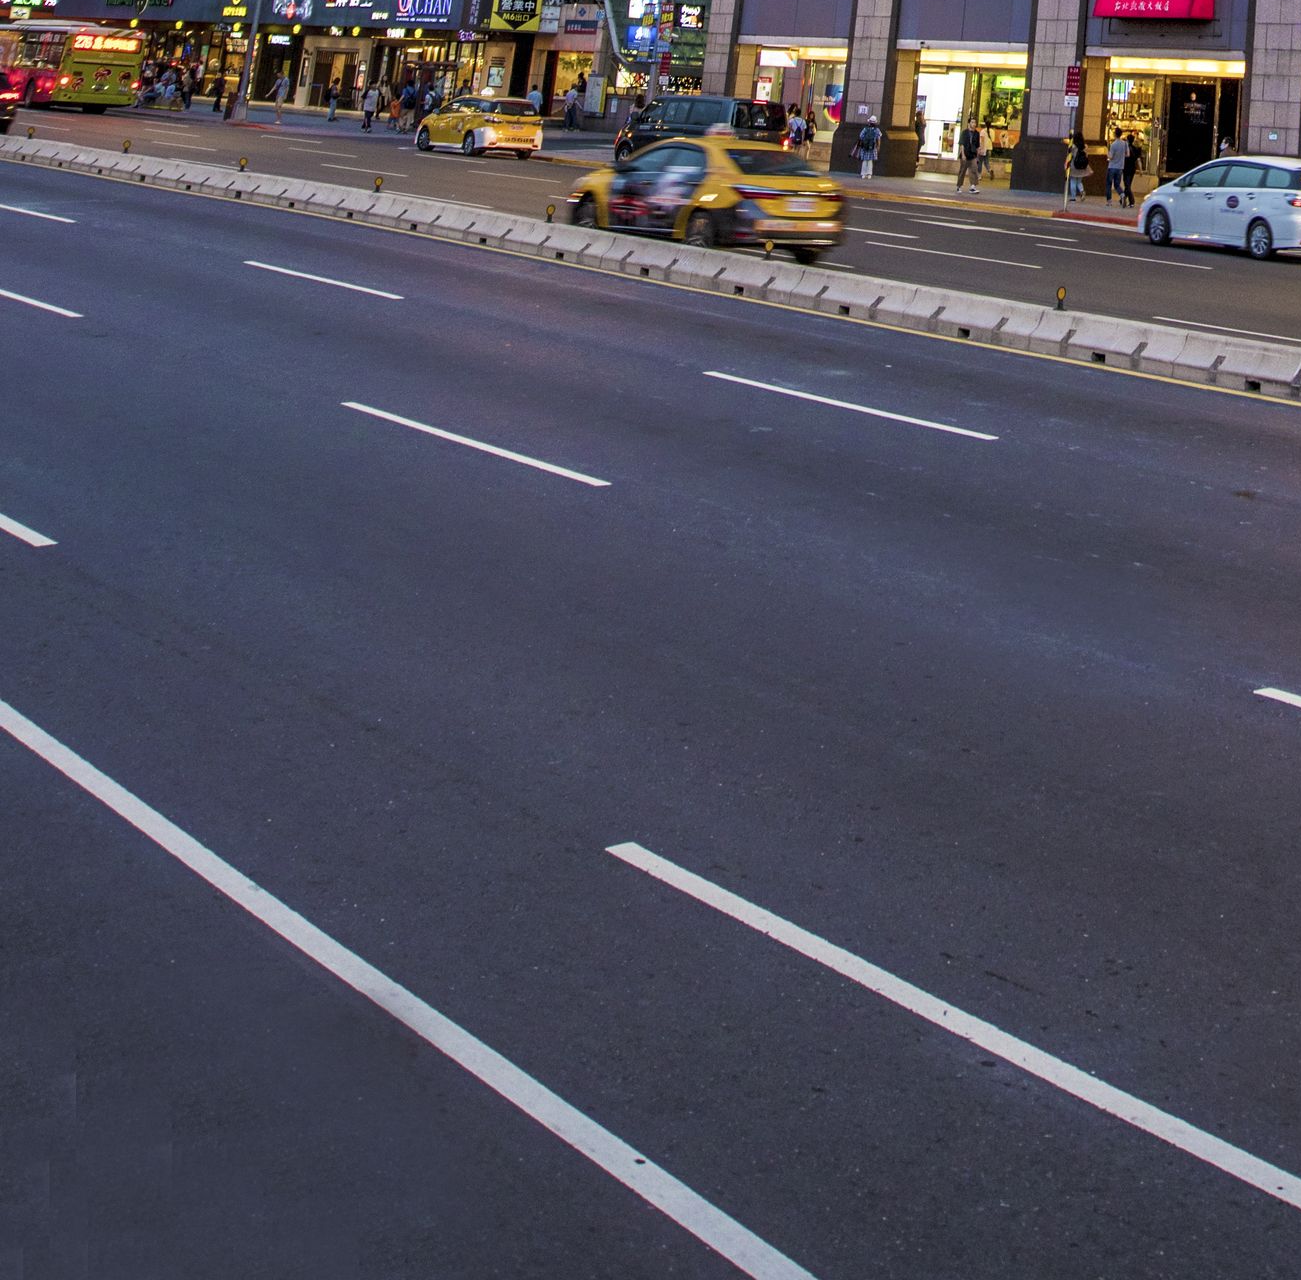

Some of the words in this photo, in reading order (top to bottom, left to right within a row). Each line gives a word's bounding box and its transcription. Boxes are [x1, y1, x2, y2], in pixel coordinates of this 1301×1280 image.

[501, 0, 535, 12] 營業中
[502, 13, 530, 22] M6出口
